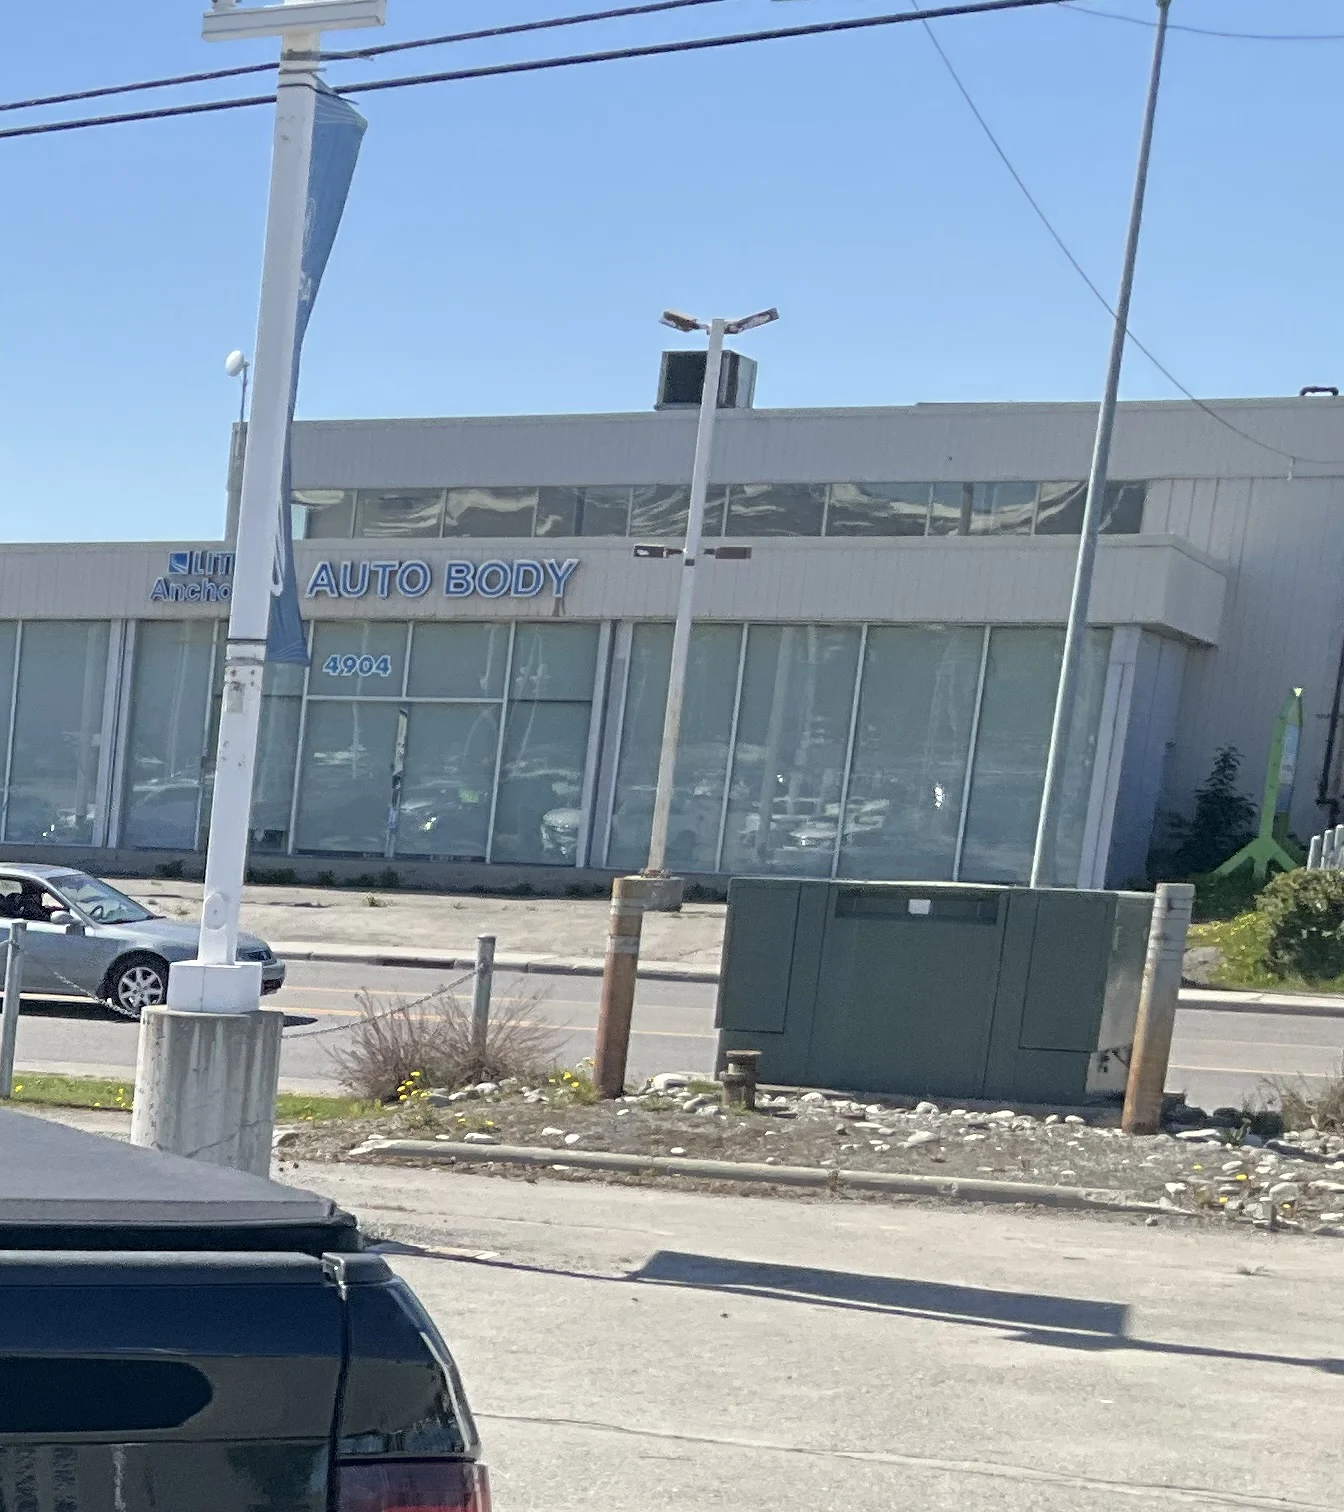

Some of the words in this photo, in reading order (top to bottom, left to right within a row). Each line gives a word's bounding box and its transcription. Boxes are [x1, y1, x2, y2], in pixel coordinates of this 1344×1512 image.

[191, 551, 237, 576] LIT
[149, 576, 234, 602] Ancho
[304, 560, 432, 598] AUTO
[443, 558, 579, 598] BODY
[322, 654, 392, 677] 4904
